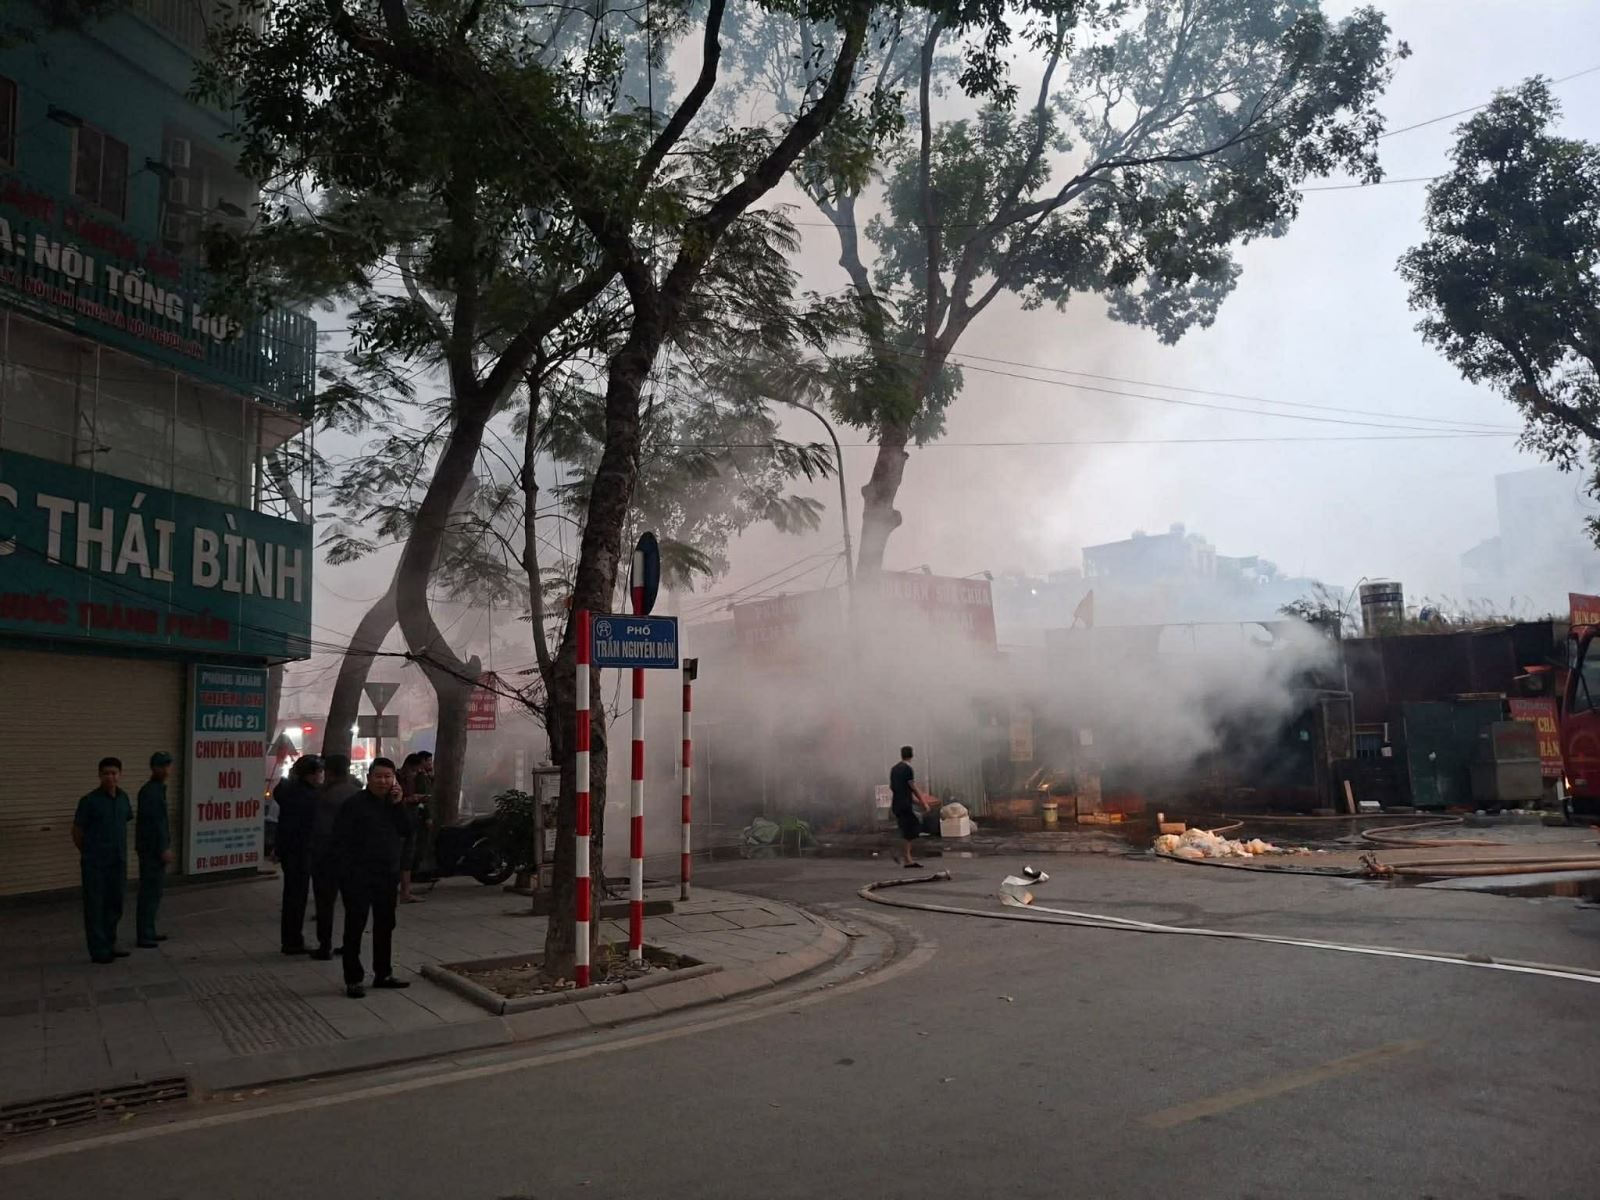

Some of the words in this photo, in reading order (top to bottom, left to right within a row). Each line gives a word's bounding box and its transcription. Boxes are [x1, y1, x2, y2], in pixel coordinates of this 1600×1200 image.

[35, 232, 95, 287] NỘI
[105, 266, 184, 324] TỔNG
[36, 492, 176, 583] THÁI
[192, 513, 304, 603] BÌNH
[626, 623, 652, 636] PHỐ
[622, 638, 656, 659] NGUYÊN
[246, 714, 260, 730] 2)
[195, 738, 235, 759] CHUYÊN
[237, 740, 264, 759] KHOA
[218, 768, 242, 793] NỘI
[197, 796, 232, 822] TỔNG
[235, 797, 261, 823] HỢP
